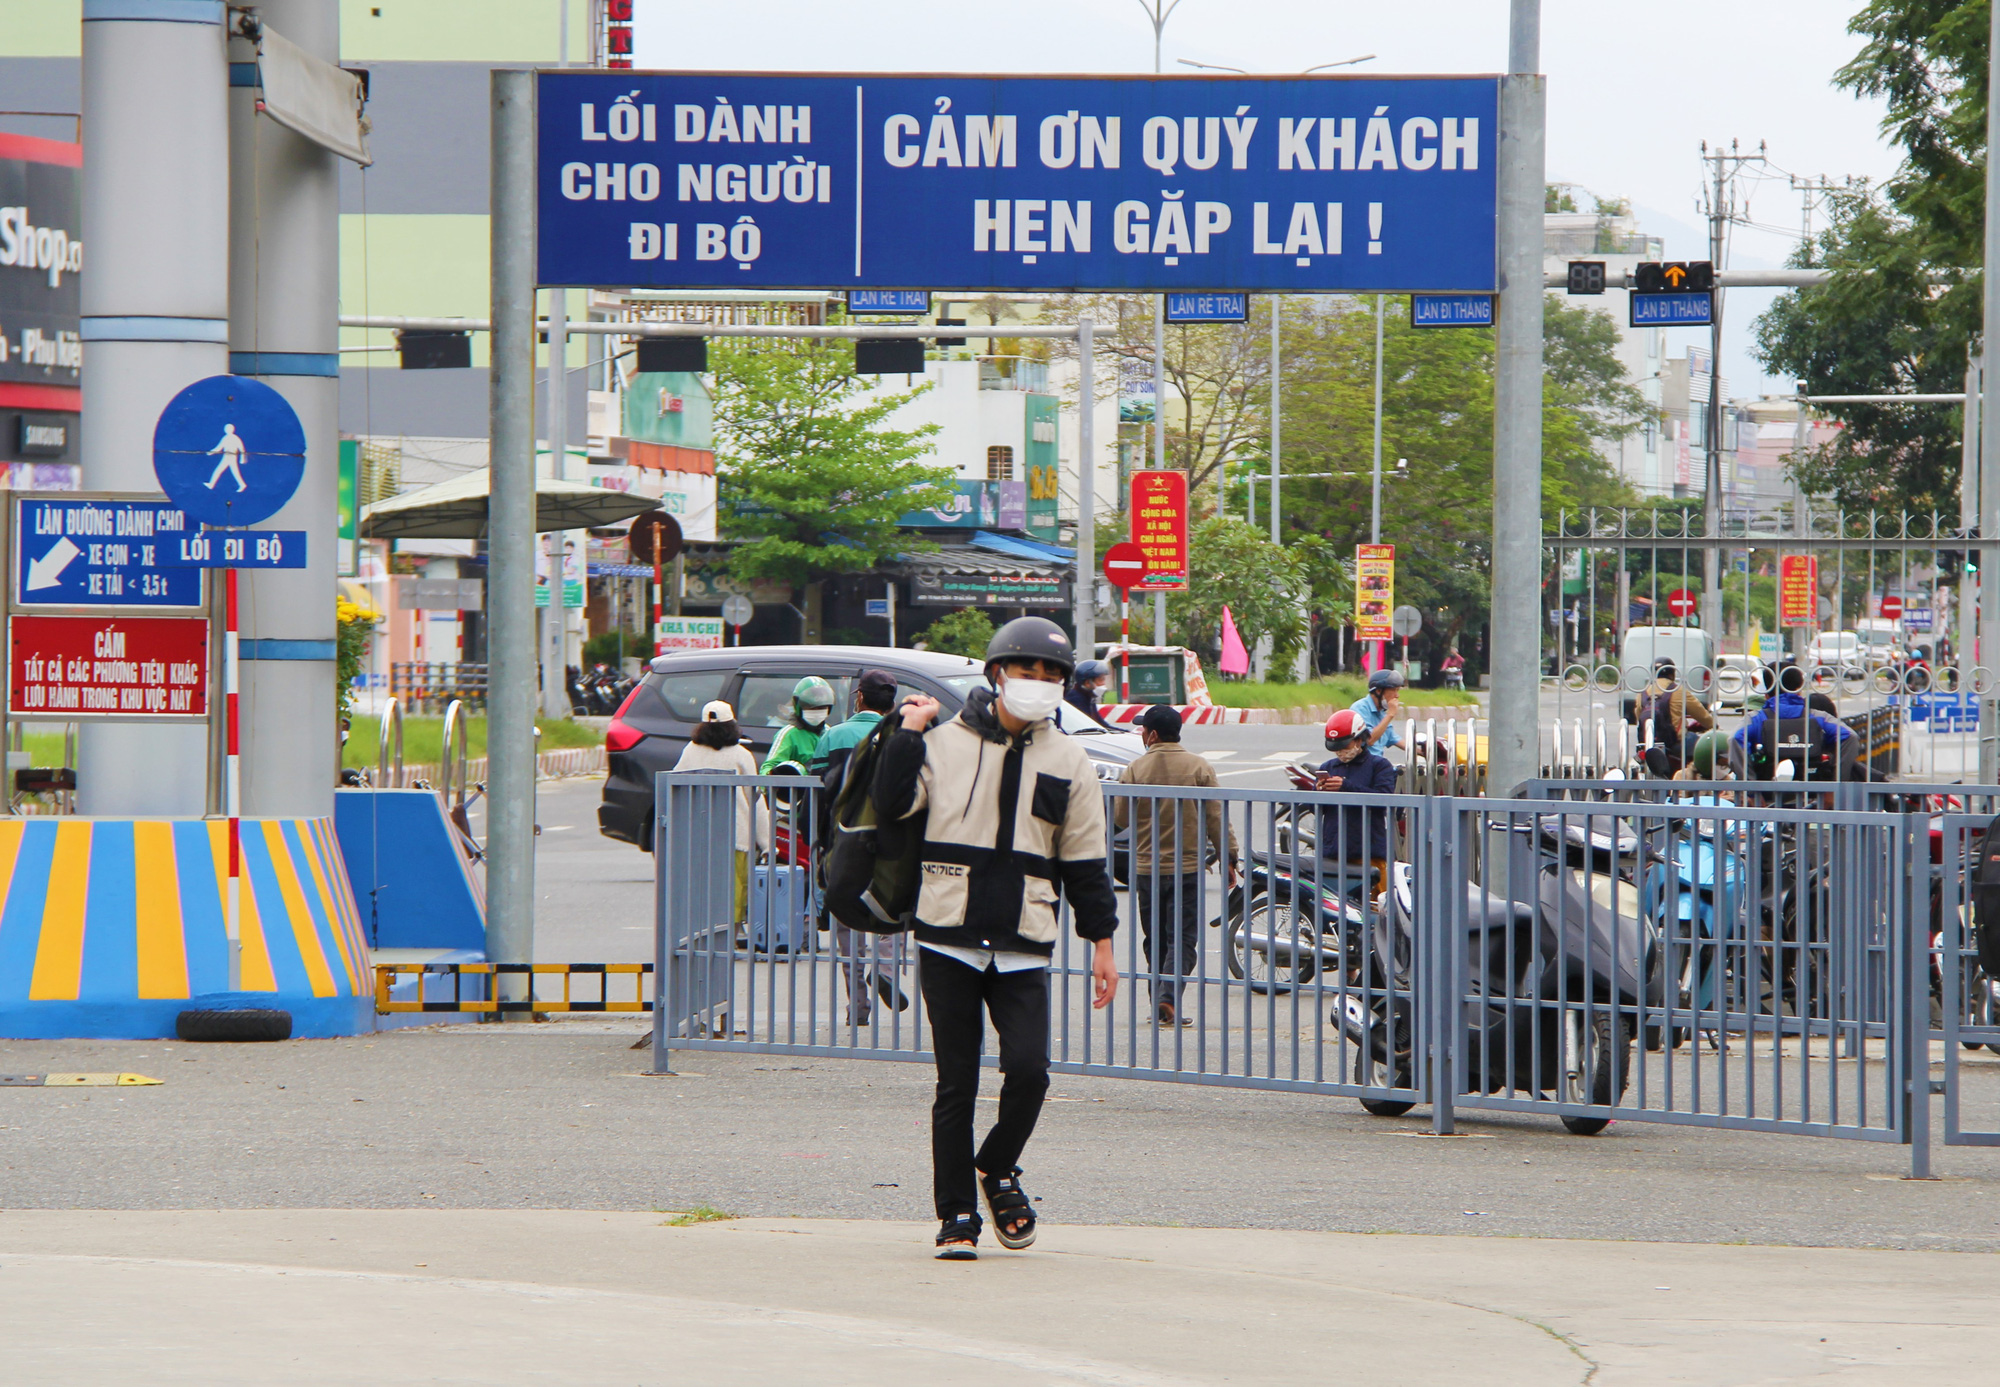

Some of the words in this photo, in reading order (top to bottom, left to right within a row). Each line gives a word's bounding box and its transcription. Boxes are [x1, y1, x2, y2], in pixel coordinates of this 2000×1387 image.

[582, 90, 656, 141] LỐI
[675, 97, 810, 143] DÀNH
[884, 97, 1016, 167] CẢM
[1040, 111, 1120, 168] ƠN
[1143, 106, 1258, 175] QUÝ
[1279, 106, 1478, 170] KHÁCH
[562, 162, 659, 201] CHO
[679, 156, 830, 202] NGƯỜI
[629, 223, 677, 260] ĐI
[697, 216, 760, 269] BỘ
[974, 200, 1091, 263] HẸN
[1114, 190, 1231, 265] GẶP
[1253, 202, 1342, 266] LẠI
[1368, 203, 1382, 254] !
[0, 206, 82, 289] Shop.c
[1170, 293, 1195, 315] LÀN
[1216, 293, 1243, 314] TRÁI
[1417, 296, 1439, 317] LÀN
[1441, 300, 1452, 317] ĐI
[1636, 298, 1658, 318] LÀN
[1659, 301, 1671, 318] ĐI
[21, 328, 57, 375] Phụ
[26, 425, 65, 446] SAMSUNG
[1140, 508, 1161, 519] CỘNG
[1148, 495, 1169, 505] NƯỚC
[36, 503, 62, 536] LÀN
[66, 502, 112, 537] ĐƯỜNG
[116, 504, 154, 537] DÀNH
[1158, 521, 1171, 531] HỘI
[180, 530, 210, 562] LỐI
[224, 537, 244, 561] ĐI
[256, 533, 283, 564] BỘ
[1140, 532, 1155, 543] CHỦ
[1156, 533, 1178, 543] NGHĨA
[1159, 548, 1177, 556] NAM
[88, 542, 103, 566] XE
[105, 542, 128, 566] CON
[141, 544, 155, 566] XE
[88, 573, 103, 596] XE
[106, 566, 123, 596] TẢI
[94, 623, 126, 659] CẤM
[24, 651, 44, 683] TẤT
[47, 653, 63, 683] CẢ
[67, 656, 89, 683] CÁC
[93, 658, 138, 685] PHƯƠNG
[140, 656, 165, 686] TIỆN
[170, 659, 199, 686] KHÁC
[24, 686, 45, 709] LƯU
[49, 682, 79, 710] HÀNH
[82, 686, 117, 711] TRONG
[120, 687, 142, 710] KHU
[145, 683, 167, 713] VỰC
[170, 685, 192, 711] NÀY
